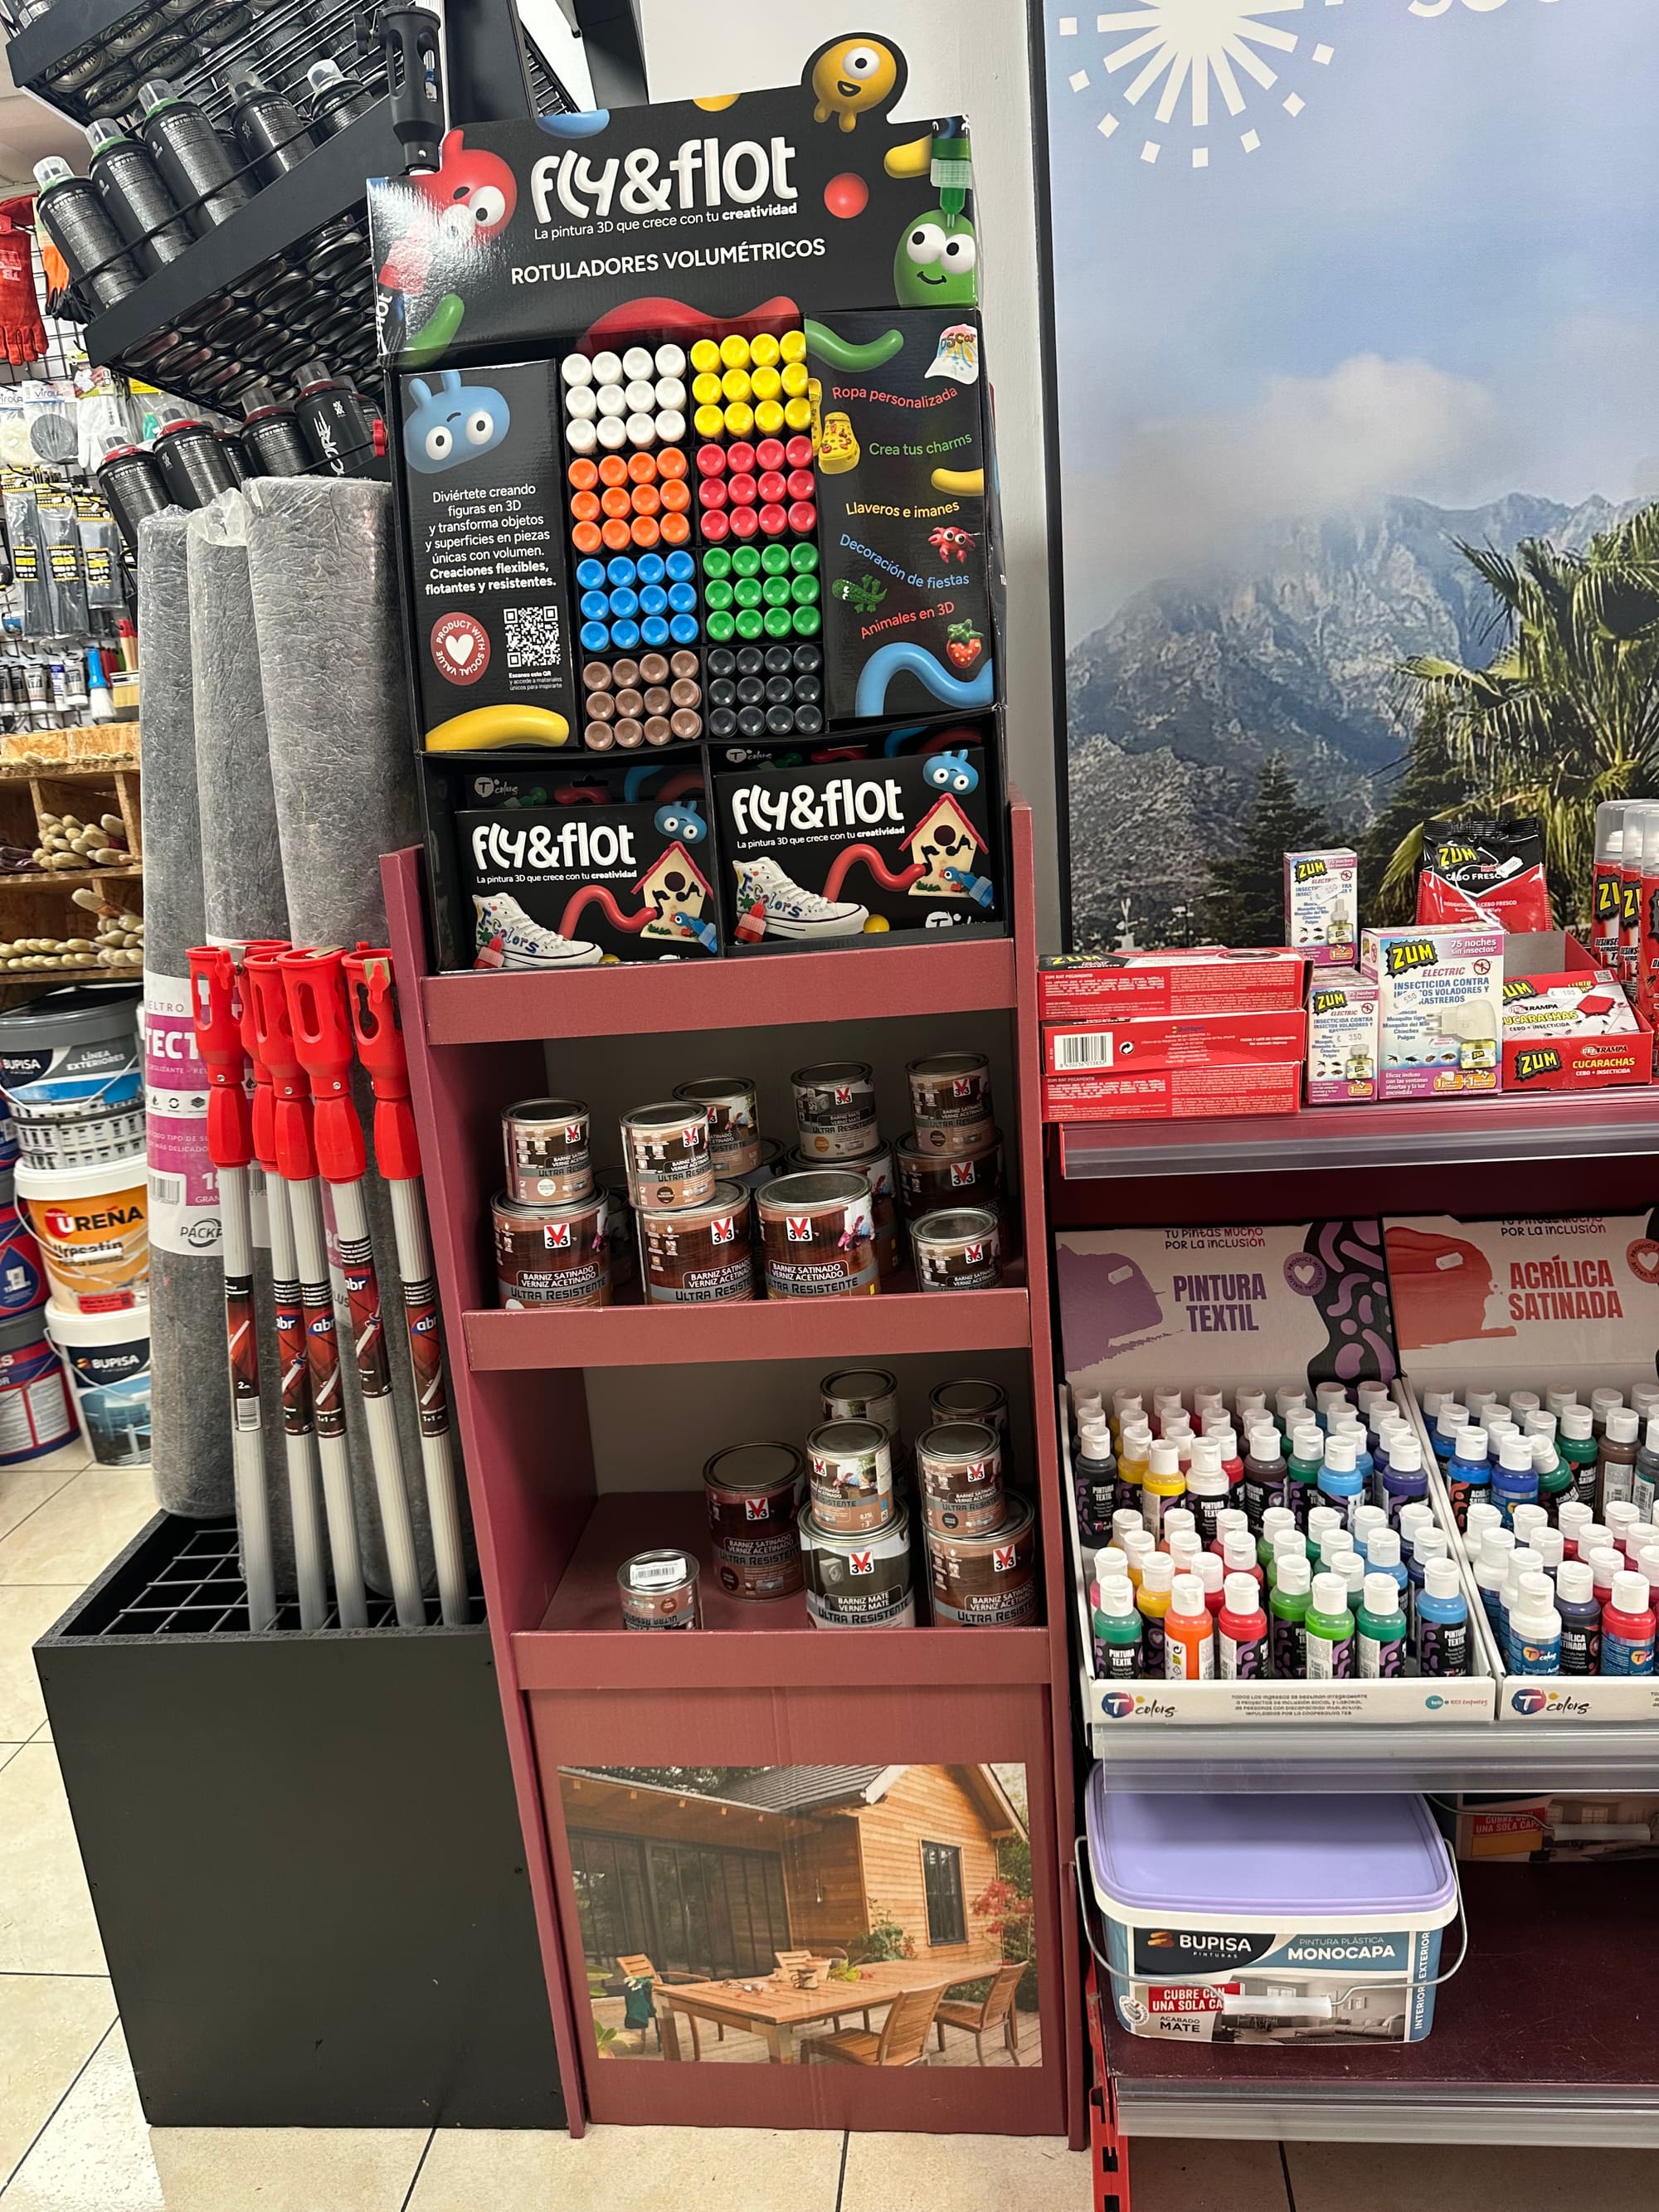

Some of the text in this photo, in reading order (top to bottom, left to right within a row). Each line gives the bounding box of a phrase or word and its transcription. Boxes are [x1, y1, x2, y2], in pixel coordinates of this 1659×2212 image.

[531, 137, 798, 223] fly&flot
[534, 202, 797, 240] La pintura 3D que crece con tu creatividad
[512, 239, 825, 284] ROTULADORES VOLUMÉTRICOS
[832, 386, 957, 408] Ropa personalizada
[869, 433, 972, 455] Crea tus charms
[433, 484, 536, 503] Diviértete creando
[448, 500, 521, 518] figuras en 3D
[845, 502, 960, 518] Llaveros e imanes
[429, 516, 543, 537] y transforma objetos
[425, 531, 550, 552] y superficies en piezas
[432, 547, 544, 564] únicas con volumen.
[839, 533, 969, 588] Decoración de fiestas
[431, 561, 548, 579] Creaciones flexibles,
[426, 576, 556, 595] flotantes y resistentes.
[860, 601, 954, 639] Animales en 3D
[435, 620, 485, 676] PRODUCT WITH SOCIAL VALUE
[732, 779, 904, 834] fly&flot
[737, 841, 746, 849] La
[748, 839, 776, 848] pintura
[790, 837, 805, 845] que
[830, 832, 844, 840] con
[857, 826, 905, 837] creatividad
[472, 823, 636, 870] fly&flot
[1438, 848, 1477, 867] ZUM
[487, 875, 513, 884] pintura
[591, 870, 637, 879] creatividad
[1298, 862, 1324, 878] ZUM
[1050, 955, 1102, 965] ZUM
[1393, 944, 1434, 970] ZUM
[1422, 967, 1466, 977] ELECTRIC
[1394, 978, 1489, 990] INSECTICIDA CONTRA
[1435, 987, 1481, 996] VOLADORES
[1317, 994, 1345, 1010] ZUM
[66, 1054, 124, 1071] EXTERIORES
[81, 1050, 110, 1061] LÍNEA
[1521, 1053, 1557, 1074] ZUM
[1573, 1057, 1635, 1068] CUCARACHAS
[523, 1266, 594, 1281] BARNIZ SATINADO
[691, 1271, 720, 1281] BARNIZ
[771, 1270, 844, 1281] VERNIZ ACETINADO
[773, 1263, 841, 1274] BARNIZ SATINADO
[1511, 1254, 1614, 1289] ACRÍLICA
[522, 1271, 596, 1287] VERNIZ ACETINADO
[688, 1279, 718, 1288] VERNIZ
[1173, 1274, 1267, 1301] PINTURA
[1508, 1291, 1623, 1320] SATINADA
[1186, 1305, 1259, 1332] TEXTIL
[92, 1354, 139, 1369] BUPISA
[868, 1592, 889, 1602] MATE
[868, 1600, 889, 1610] MATE
[972, 1595, 1002, 1604] BARNIZ
[971, 1602, 999, 1612] VERNIZ
[1109, 1649, 1135, 1657] PINTURA
[1112, 1658, 1132, 1666] TEXTIL
[1136, 1699, 1179, 1717] colors
[1546, 1696, 1592, 1714] colors
[1180, 1935, 1252, 1952] BUPISA
[1299, 1935, 1384, 1946] PINTURA PLÁSTICA
[1287, 1945, 1395, 1961] MONOCAPA
[1414, 1931, 1430, 2030] INTERIOR EXTERIOR
[1164, 1990, 1199, 2000] CUBRE
[1153, 2000, 1205, 2011] UNA SOLA
[1160, 2022, 1200, 2032] MATE
